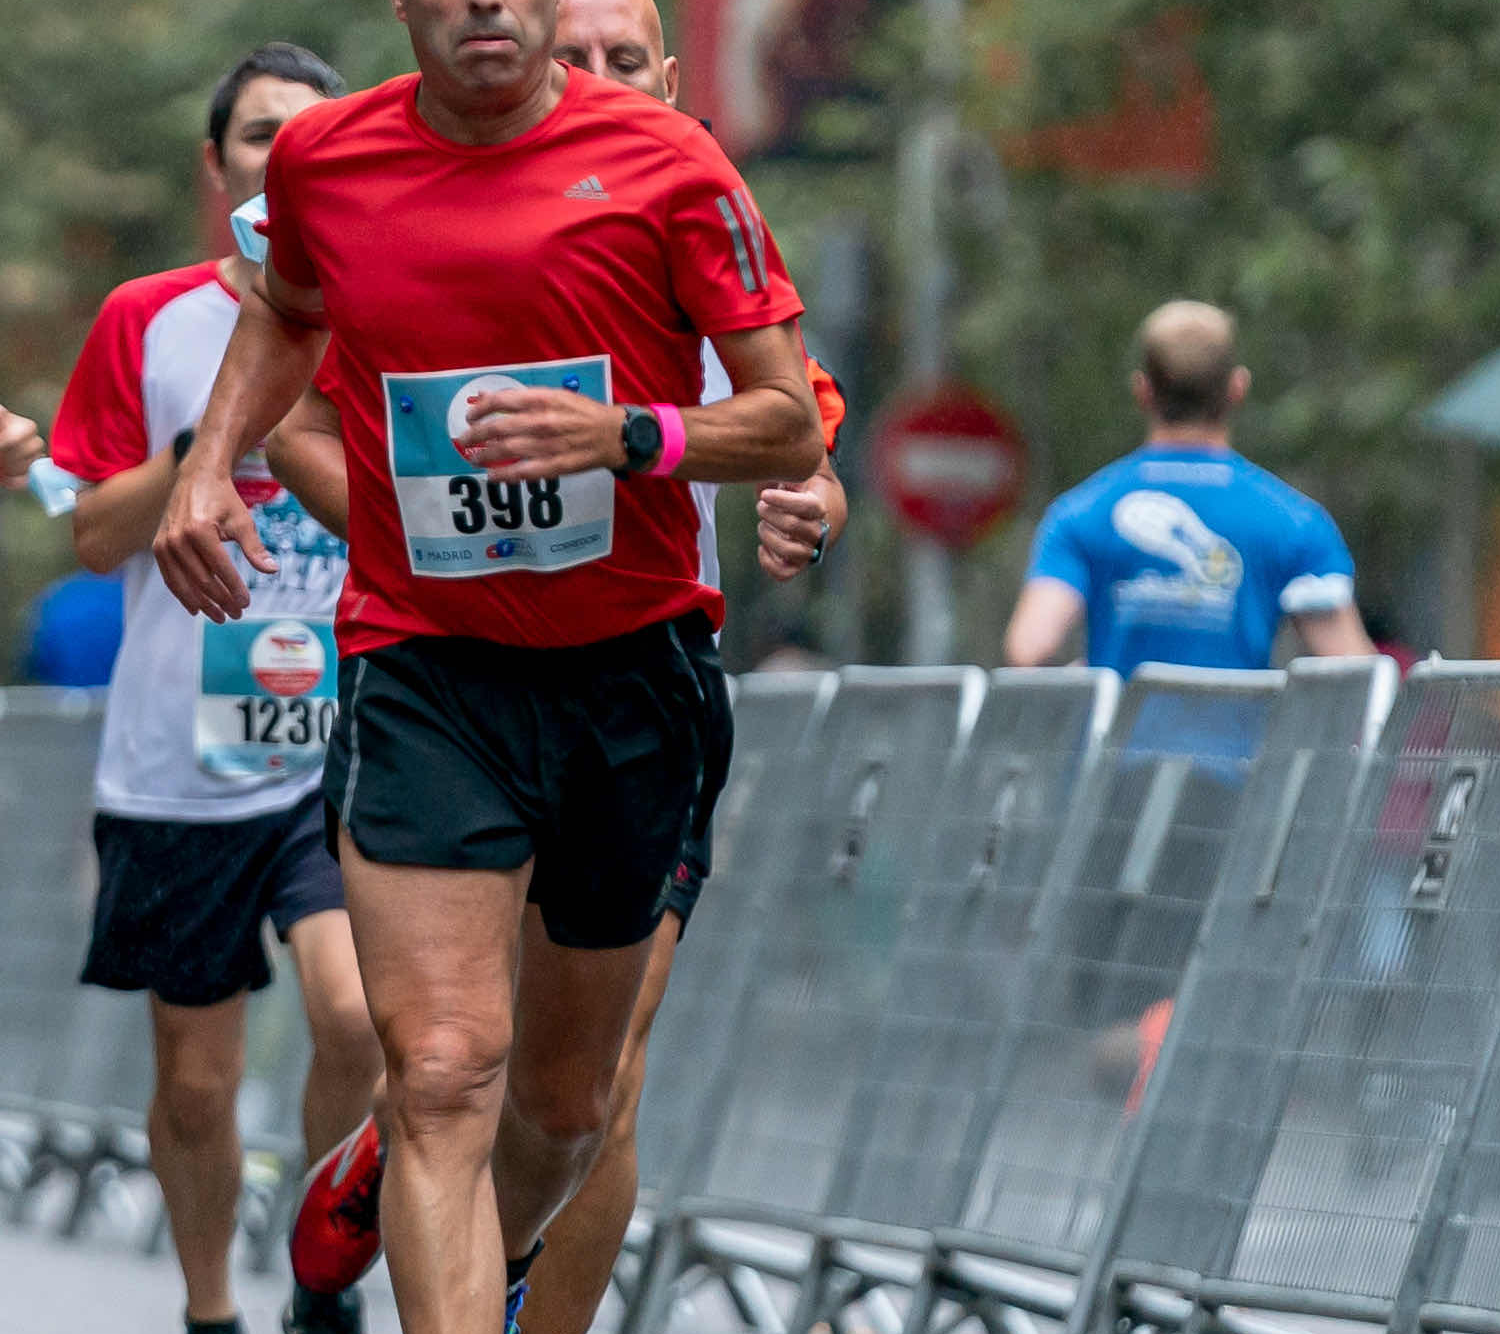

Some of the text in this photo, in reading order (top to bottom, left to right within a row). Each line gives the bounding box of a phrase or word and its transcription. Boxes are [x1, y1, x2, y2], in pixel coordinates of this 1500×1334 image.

[448, 475, 564, 535] 398
[427, 548, 473, 562] MADRID
[237, 697, 335, 745] 1230
